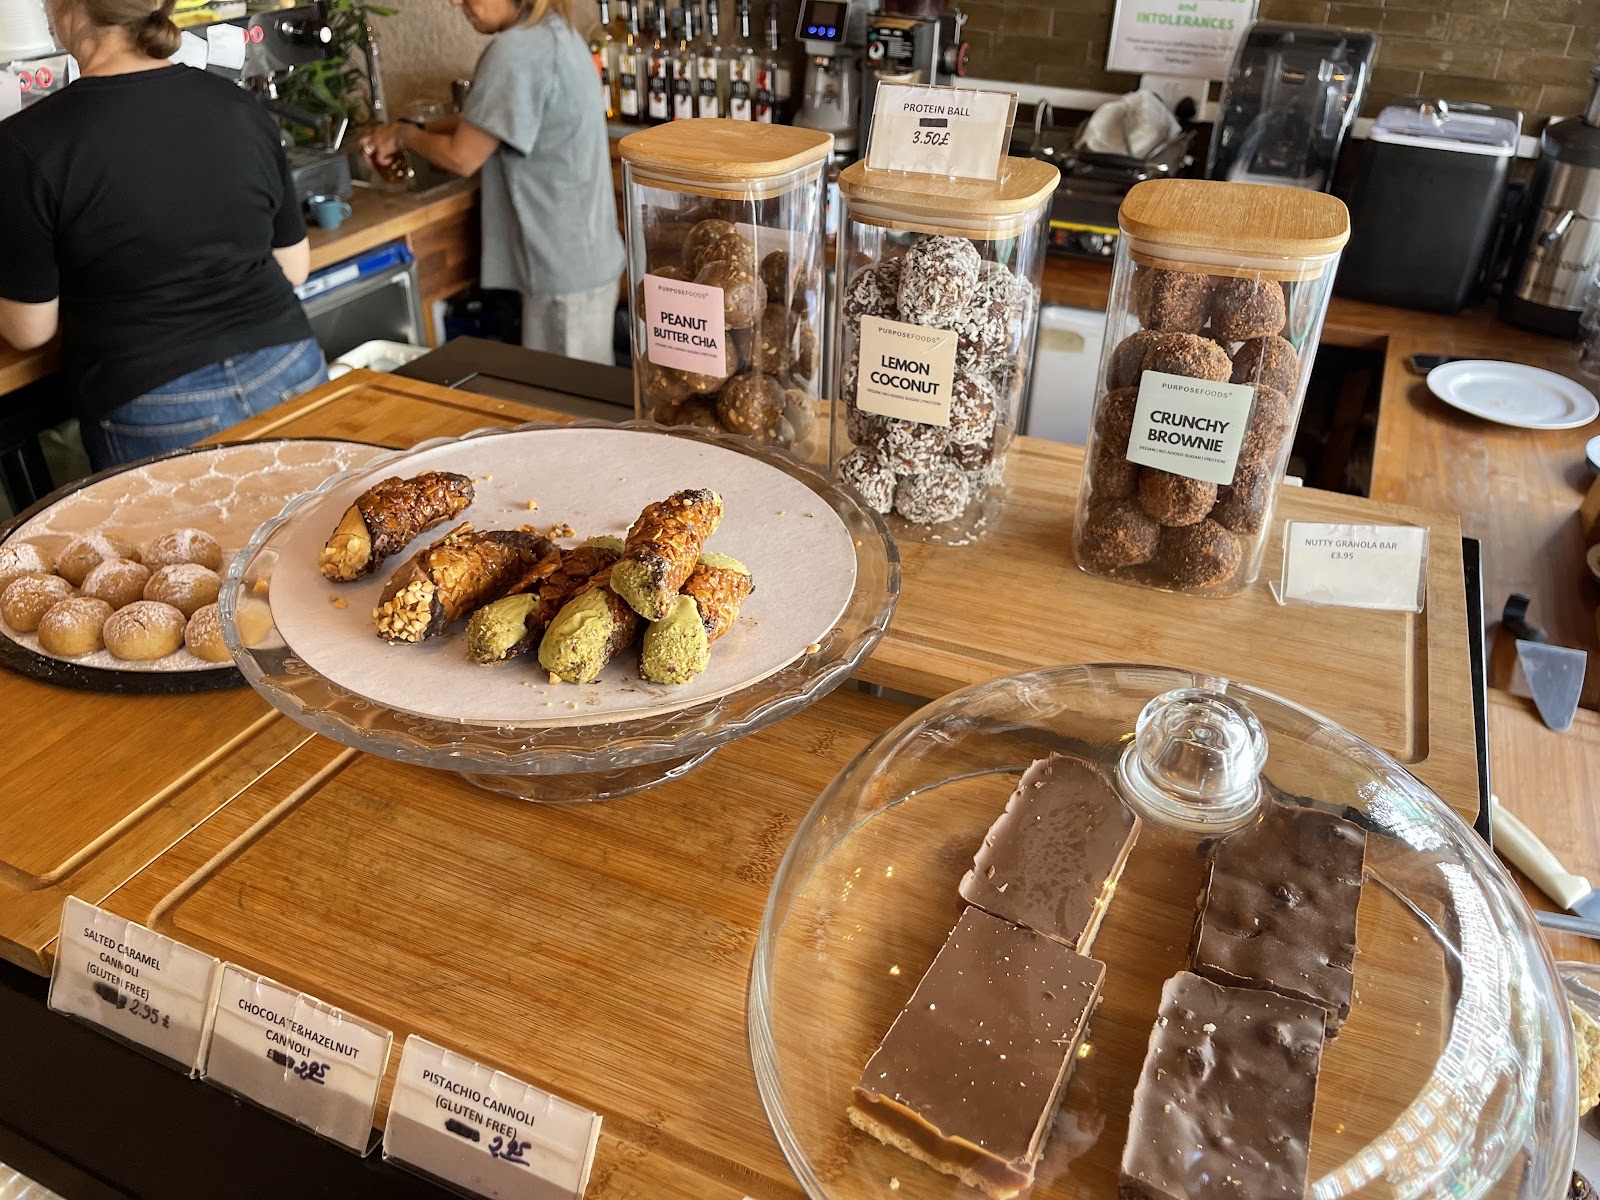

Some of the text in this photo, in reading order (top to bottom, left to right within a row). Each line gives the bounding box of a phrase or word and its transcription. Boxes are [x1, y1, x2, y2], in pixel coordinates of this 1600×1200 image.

[1136, 12, 1235, 30] INTOLERANCES
[903, 103, 970, 116] PROTEIN BALL
[912, 130, 950, 146] 3.50£
[660, 312, 708, 331] PEANUT
[654, 326, 718, 349] BUTTER CHIA
[881, 354, 930, 376] LEMON
[870, 371, 940, 395] COCONUT
[1150, 410, 1230, 434] CRUNCHY
[1147, 428, 1224, 453] BROWNIE
[1304, 539, 1397, 550] NUTTY GRANOLA BAR
[1330, 552, 1354, 560] £3.95
[84, 928, 161, 971] SALTED CARAMEL
[99, 952, 139, 977] CANNOLI
[87, 962, 123, 988] (GLUTEN
[125, 981, 150, 1001] FREE)
[129, 998, 160, 1024] 2.95
[238, 998, 360, 1059] CHOCOLATE&HAZELNUT
[265, 1029, 311, 1058] CANNOLI
[422, 1069, 535, 1127] PISTACHIO CANNOLI
[436, 1094, 484, 1124] (GLUTEN
[486, 1117, 517, 1141] FREE)
